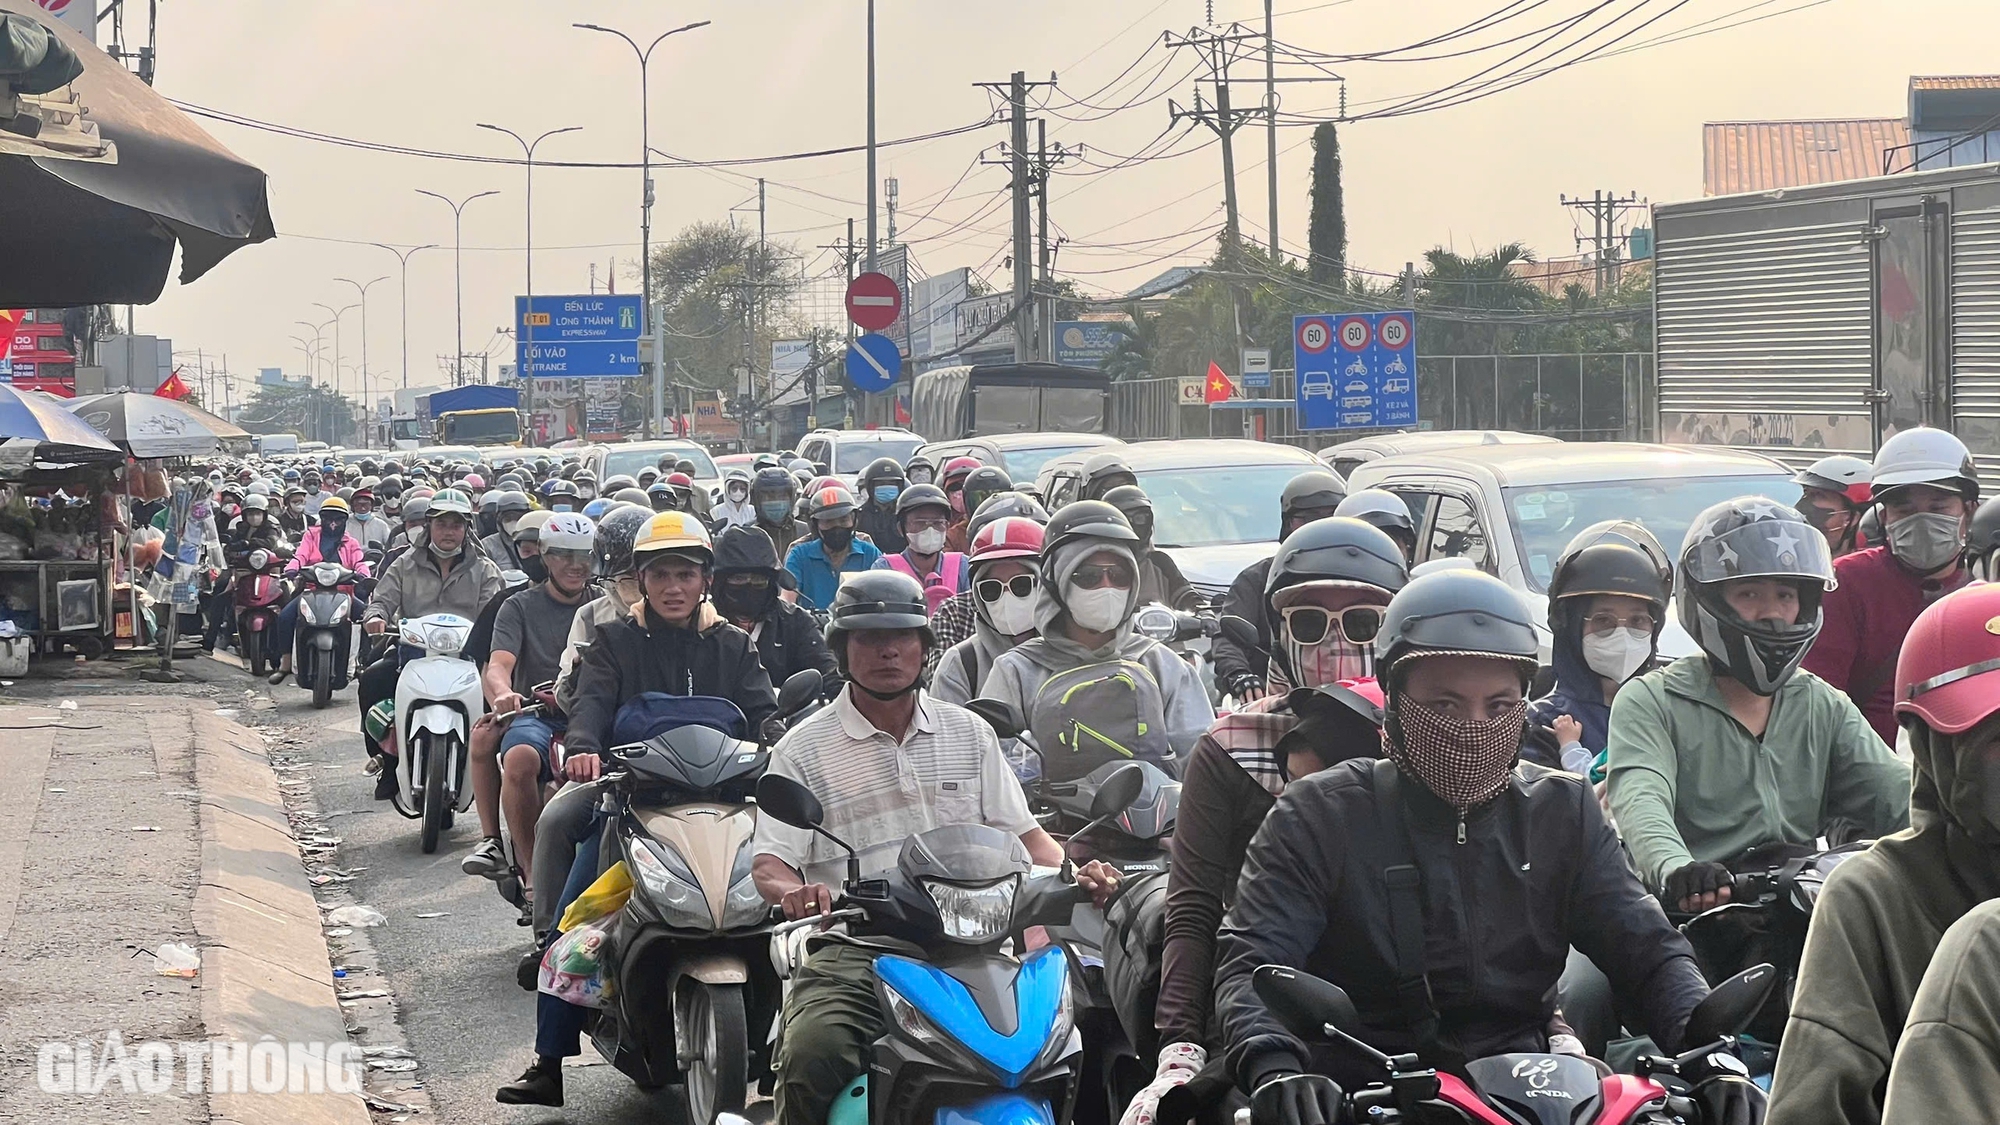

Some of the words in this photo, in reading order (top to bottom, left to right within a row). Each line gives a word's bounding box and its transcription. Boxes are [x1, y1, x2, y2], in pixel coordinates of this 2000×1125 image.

[556, 317, 579, 326] LONG
[583, 315, 614, 326] THÀNH
[1308, 329, 1321, 342] 60
[1348, 327, 1361, 341] 60
[1387, 326, 1400, 339] 60
[15, 336, 31, 344] DO
[544, 346, 566, 358] VÀO
[609, 354, 615, 364] 2
[620, 353, 636, 363] km
